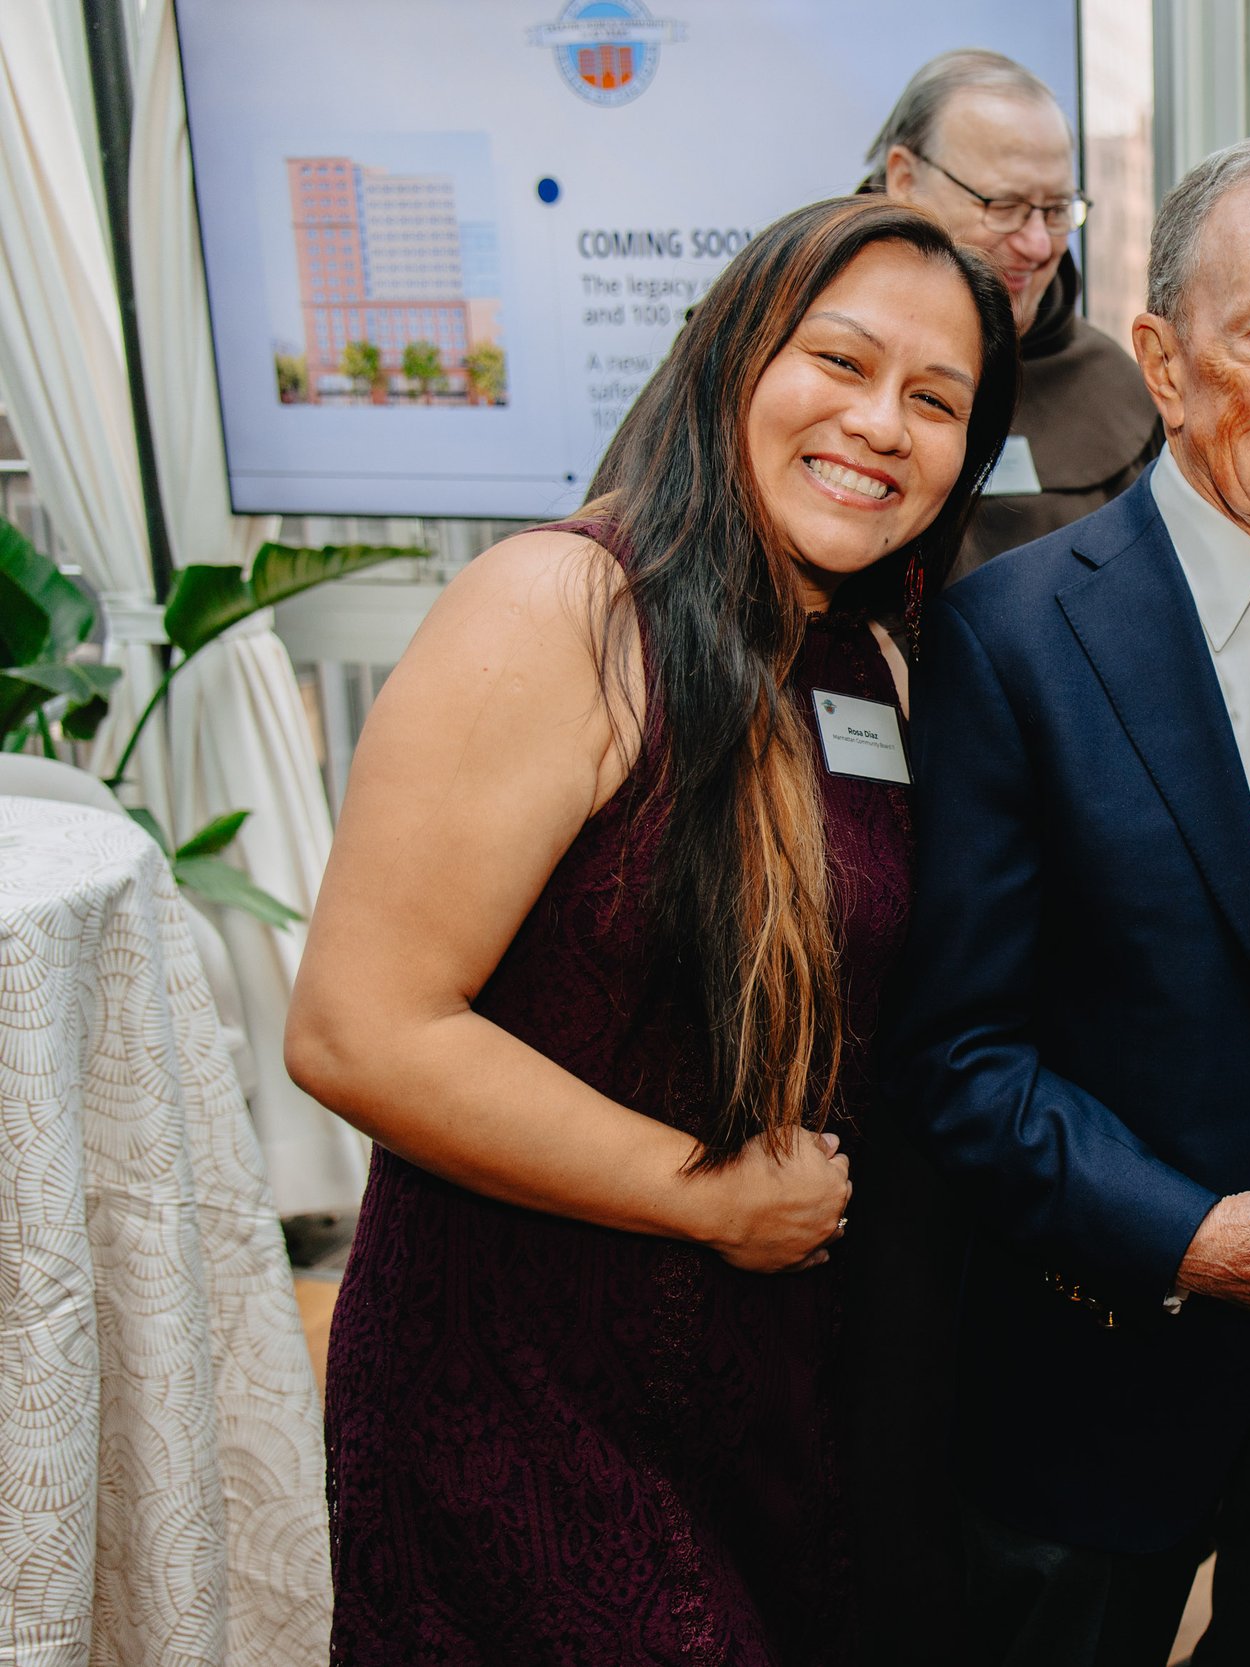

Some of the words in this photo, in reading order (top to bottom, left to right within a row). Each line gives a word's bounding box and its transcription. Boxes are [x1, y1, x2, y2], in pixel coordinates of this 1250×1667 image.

[579, 230, 683, 259] COMING
[581, 273, 622, 297] The
[627, 274, 697, 301] legacy
[582, 304, 625, 325] and
[632, 304, 671, 325] 100
[847, 727, 863, 737] Rosa
[864, 730, 879, 740] Diaz
